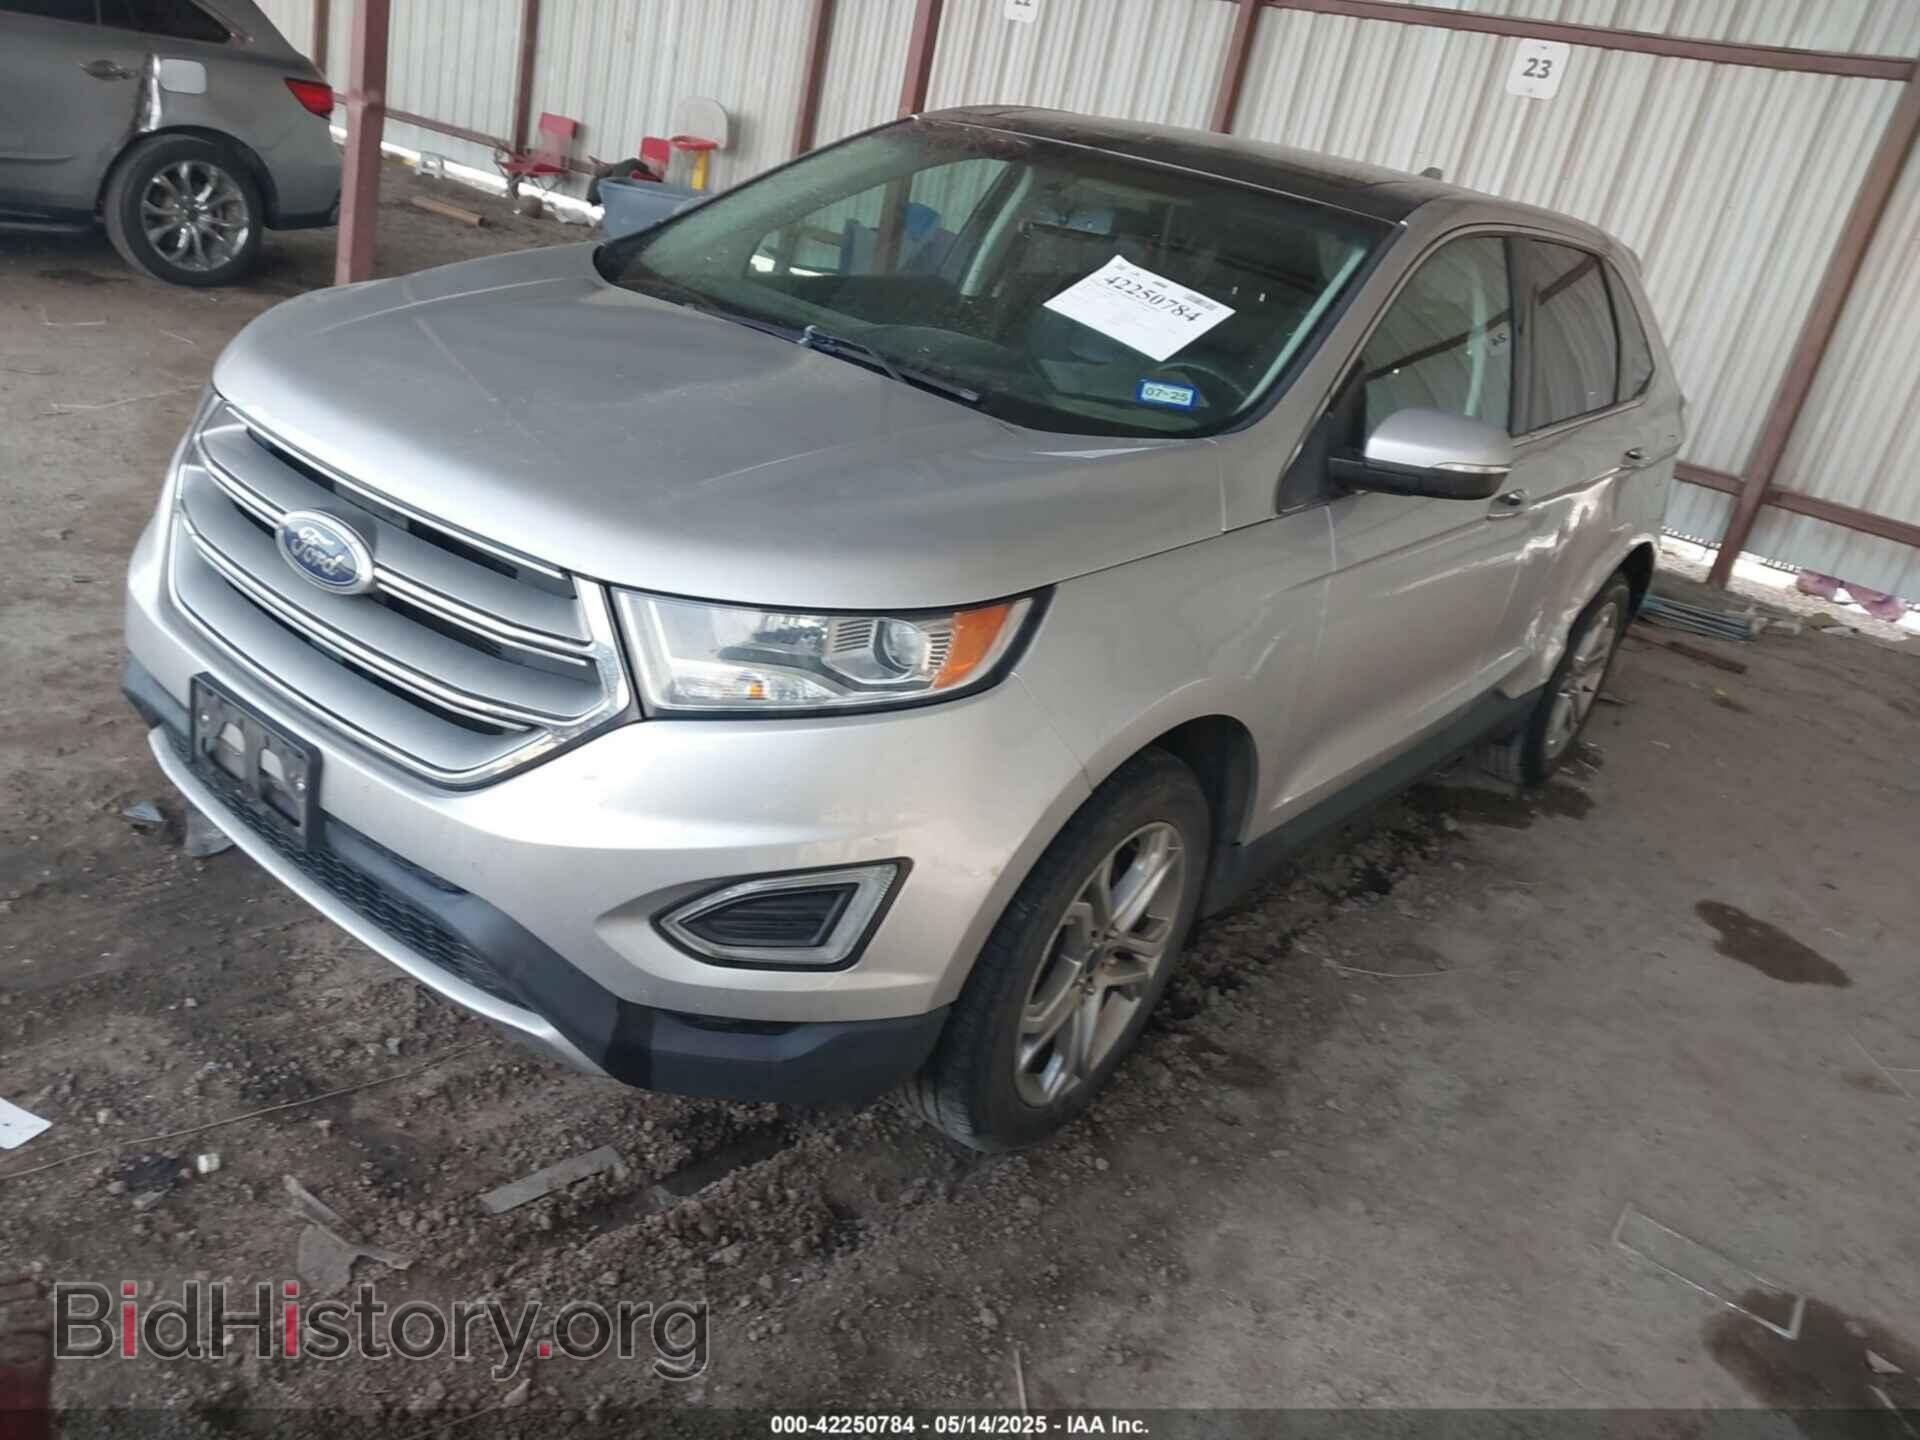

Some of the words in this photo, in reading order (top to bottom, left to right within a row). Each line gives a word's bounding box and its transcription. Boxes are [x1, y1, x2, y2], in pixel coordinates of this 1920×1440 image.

[1522, 57, 1552, 79] 23
[1104, 276, 1202, 321] 42250784
[291, 526, 345, 576] Ford
